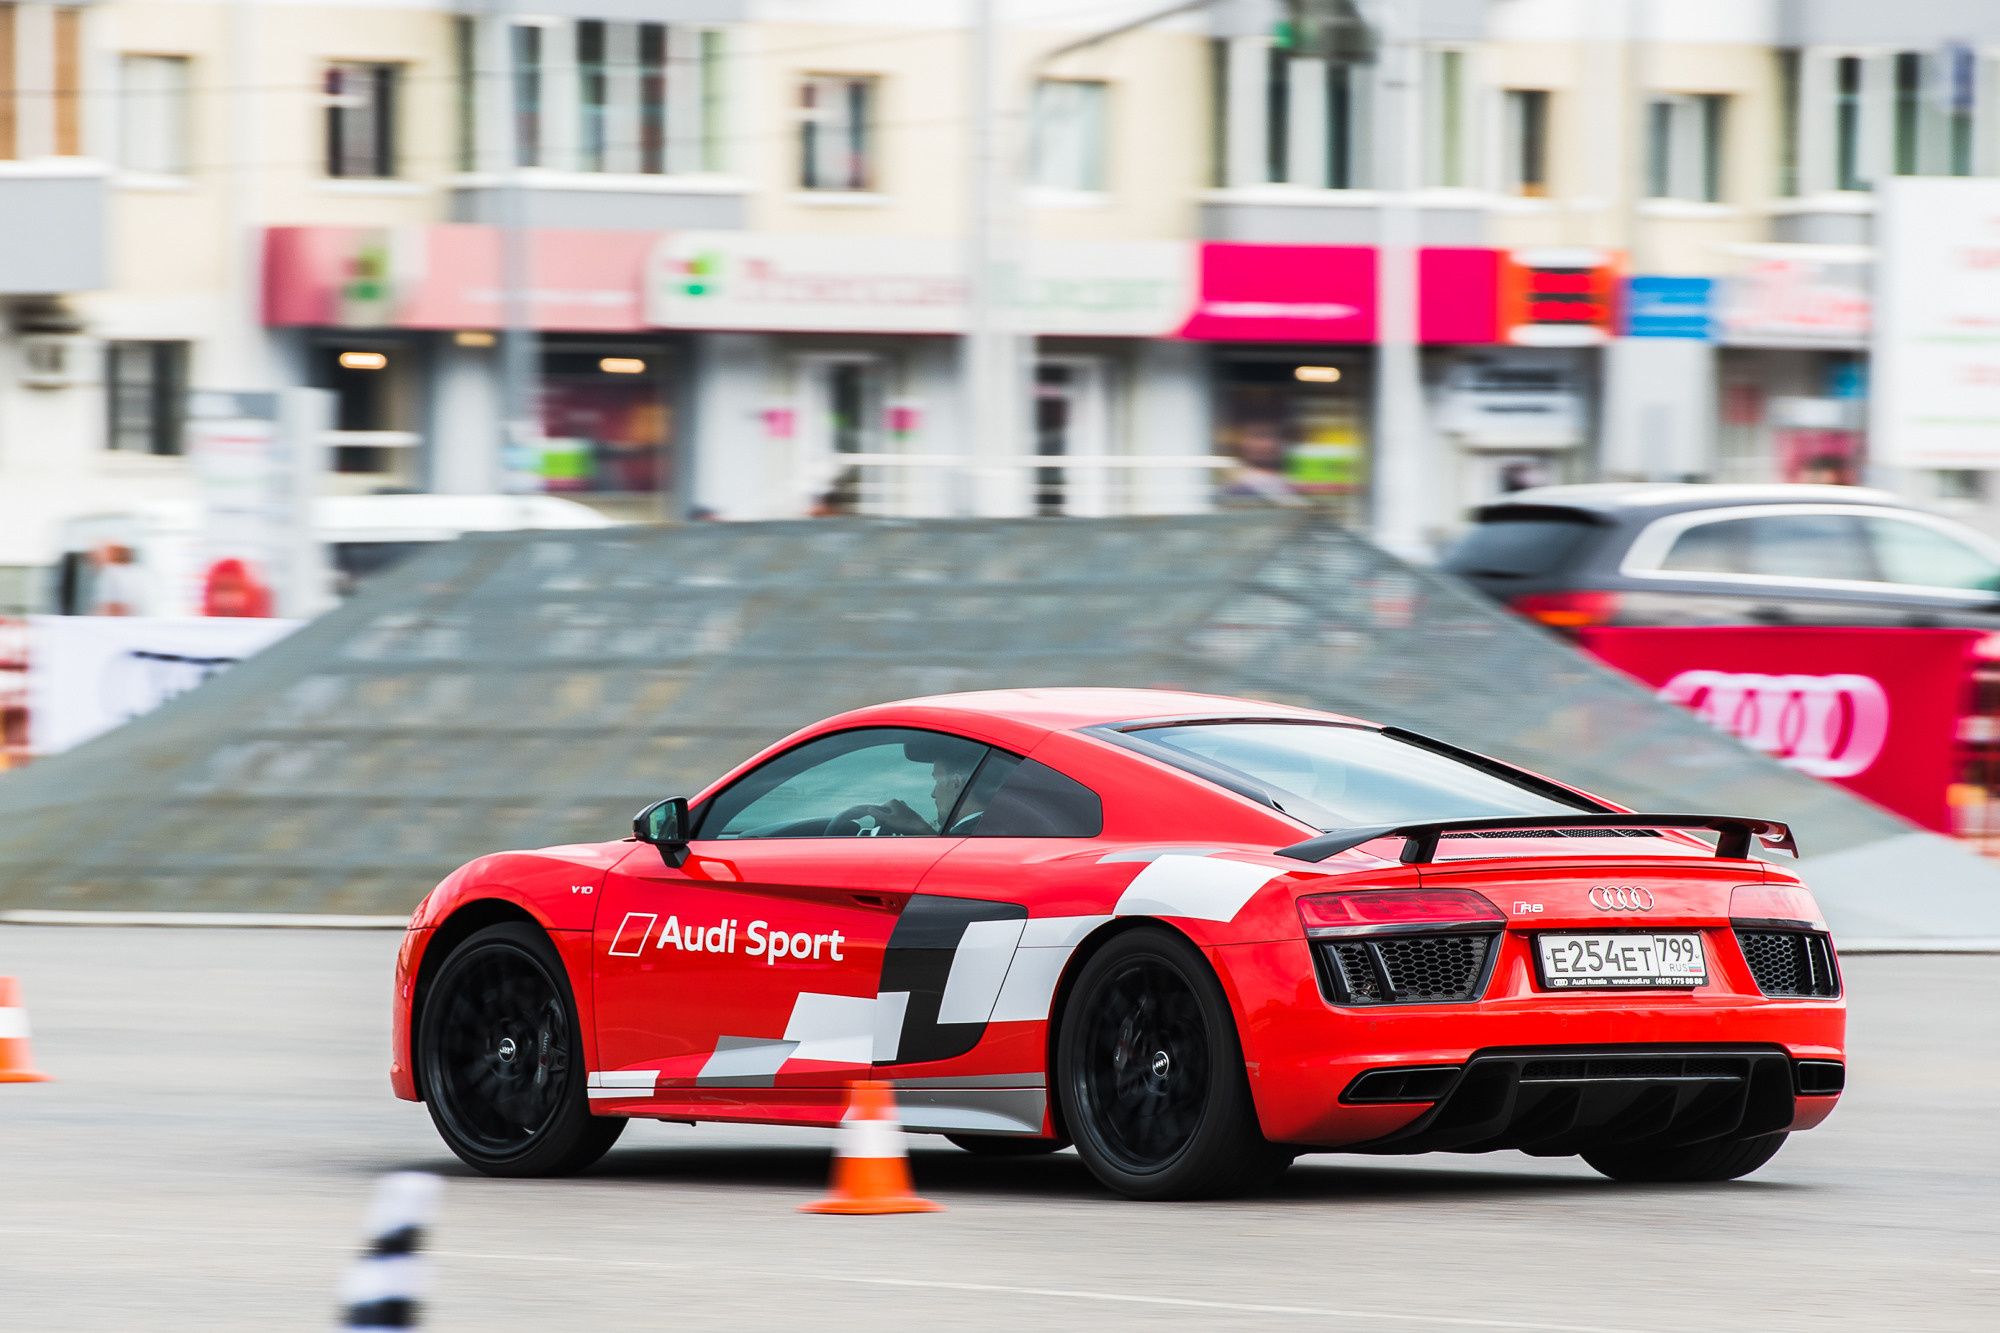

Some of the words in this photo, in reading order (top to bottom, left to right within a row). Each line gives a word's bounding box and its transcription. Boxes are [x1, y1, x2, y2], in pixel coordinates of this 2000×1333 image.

[1520, 903, 1544, 913] R8
[656, 915, 737, 954] Audi
[745, 920, 845, 965] Sport
[1551, 940, 1652, 973] E254ET
[1656, 938, 1694, 962] 799
[1669, 963, 1688, 973] RUS
[1572, 978, 1586, 986] Audi
[1588, 977, 1607, 985] Russia
[1612, 977, 1650, 985] www.audi.ru
[1655, 977, 1671, 986] (495)
